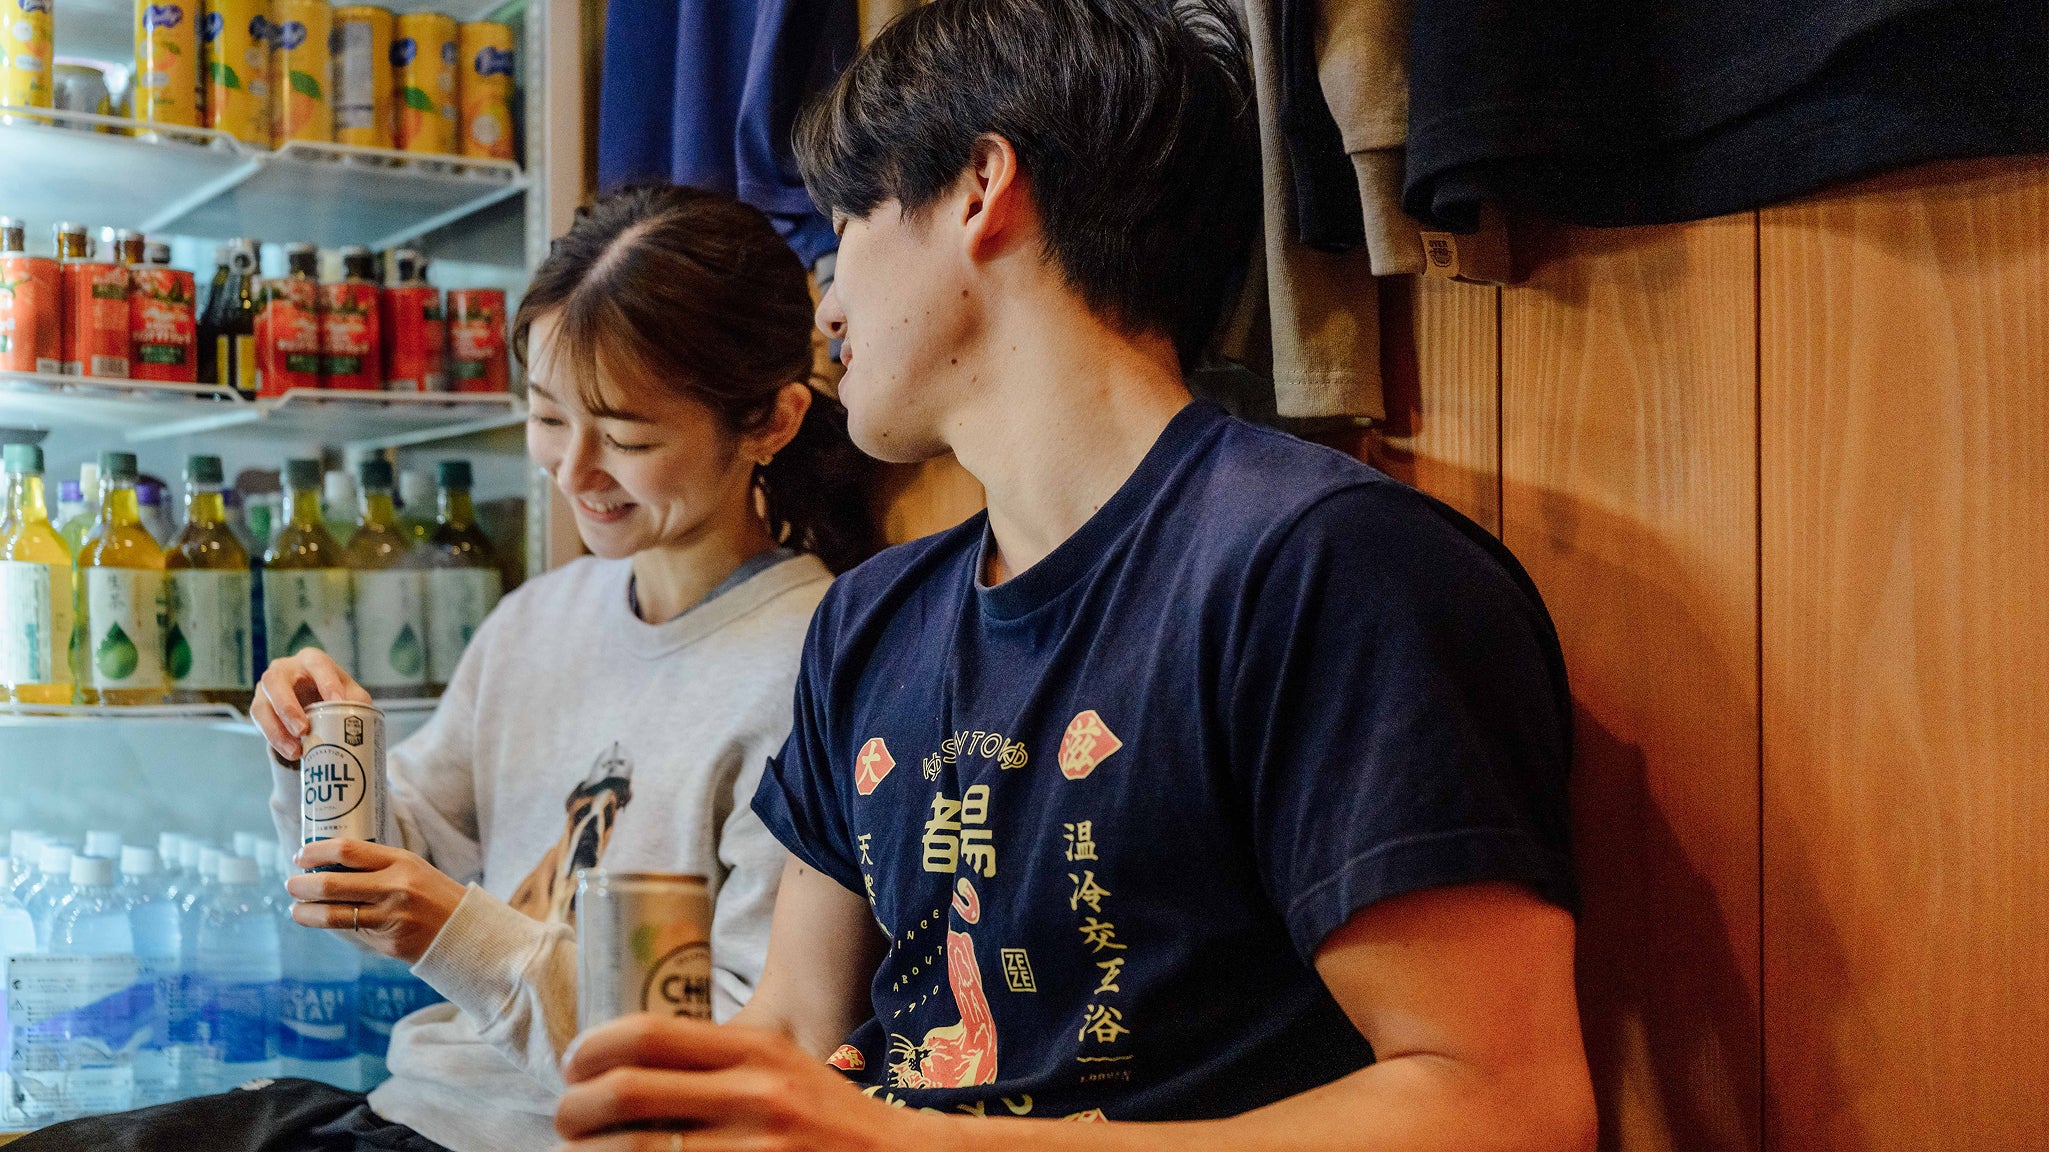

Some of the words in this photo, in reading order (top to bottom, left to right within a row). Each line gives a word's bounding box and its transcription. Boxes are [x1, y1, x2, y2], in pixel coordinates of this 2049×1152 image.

[304, 763, 355, 786] CHILL
[857, 741, 881, 785] 大
[305, 783, 348, 804] OUT
[1063, 819, 1131, 1044] 温冷交互浴
[893, 945, 943, 992] ABOUT
[661, 975, 712, 1004] CHI
